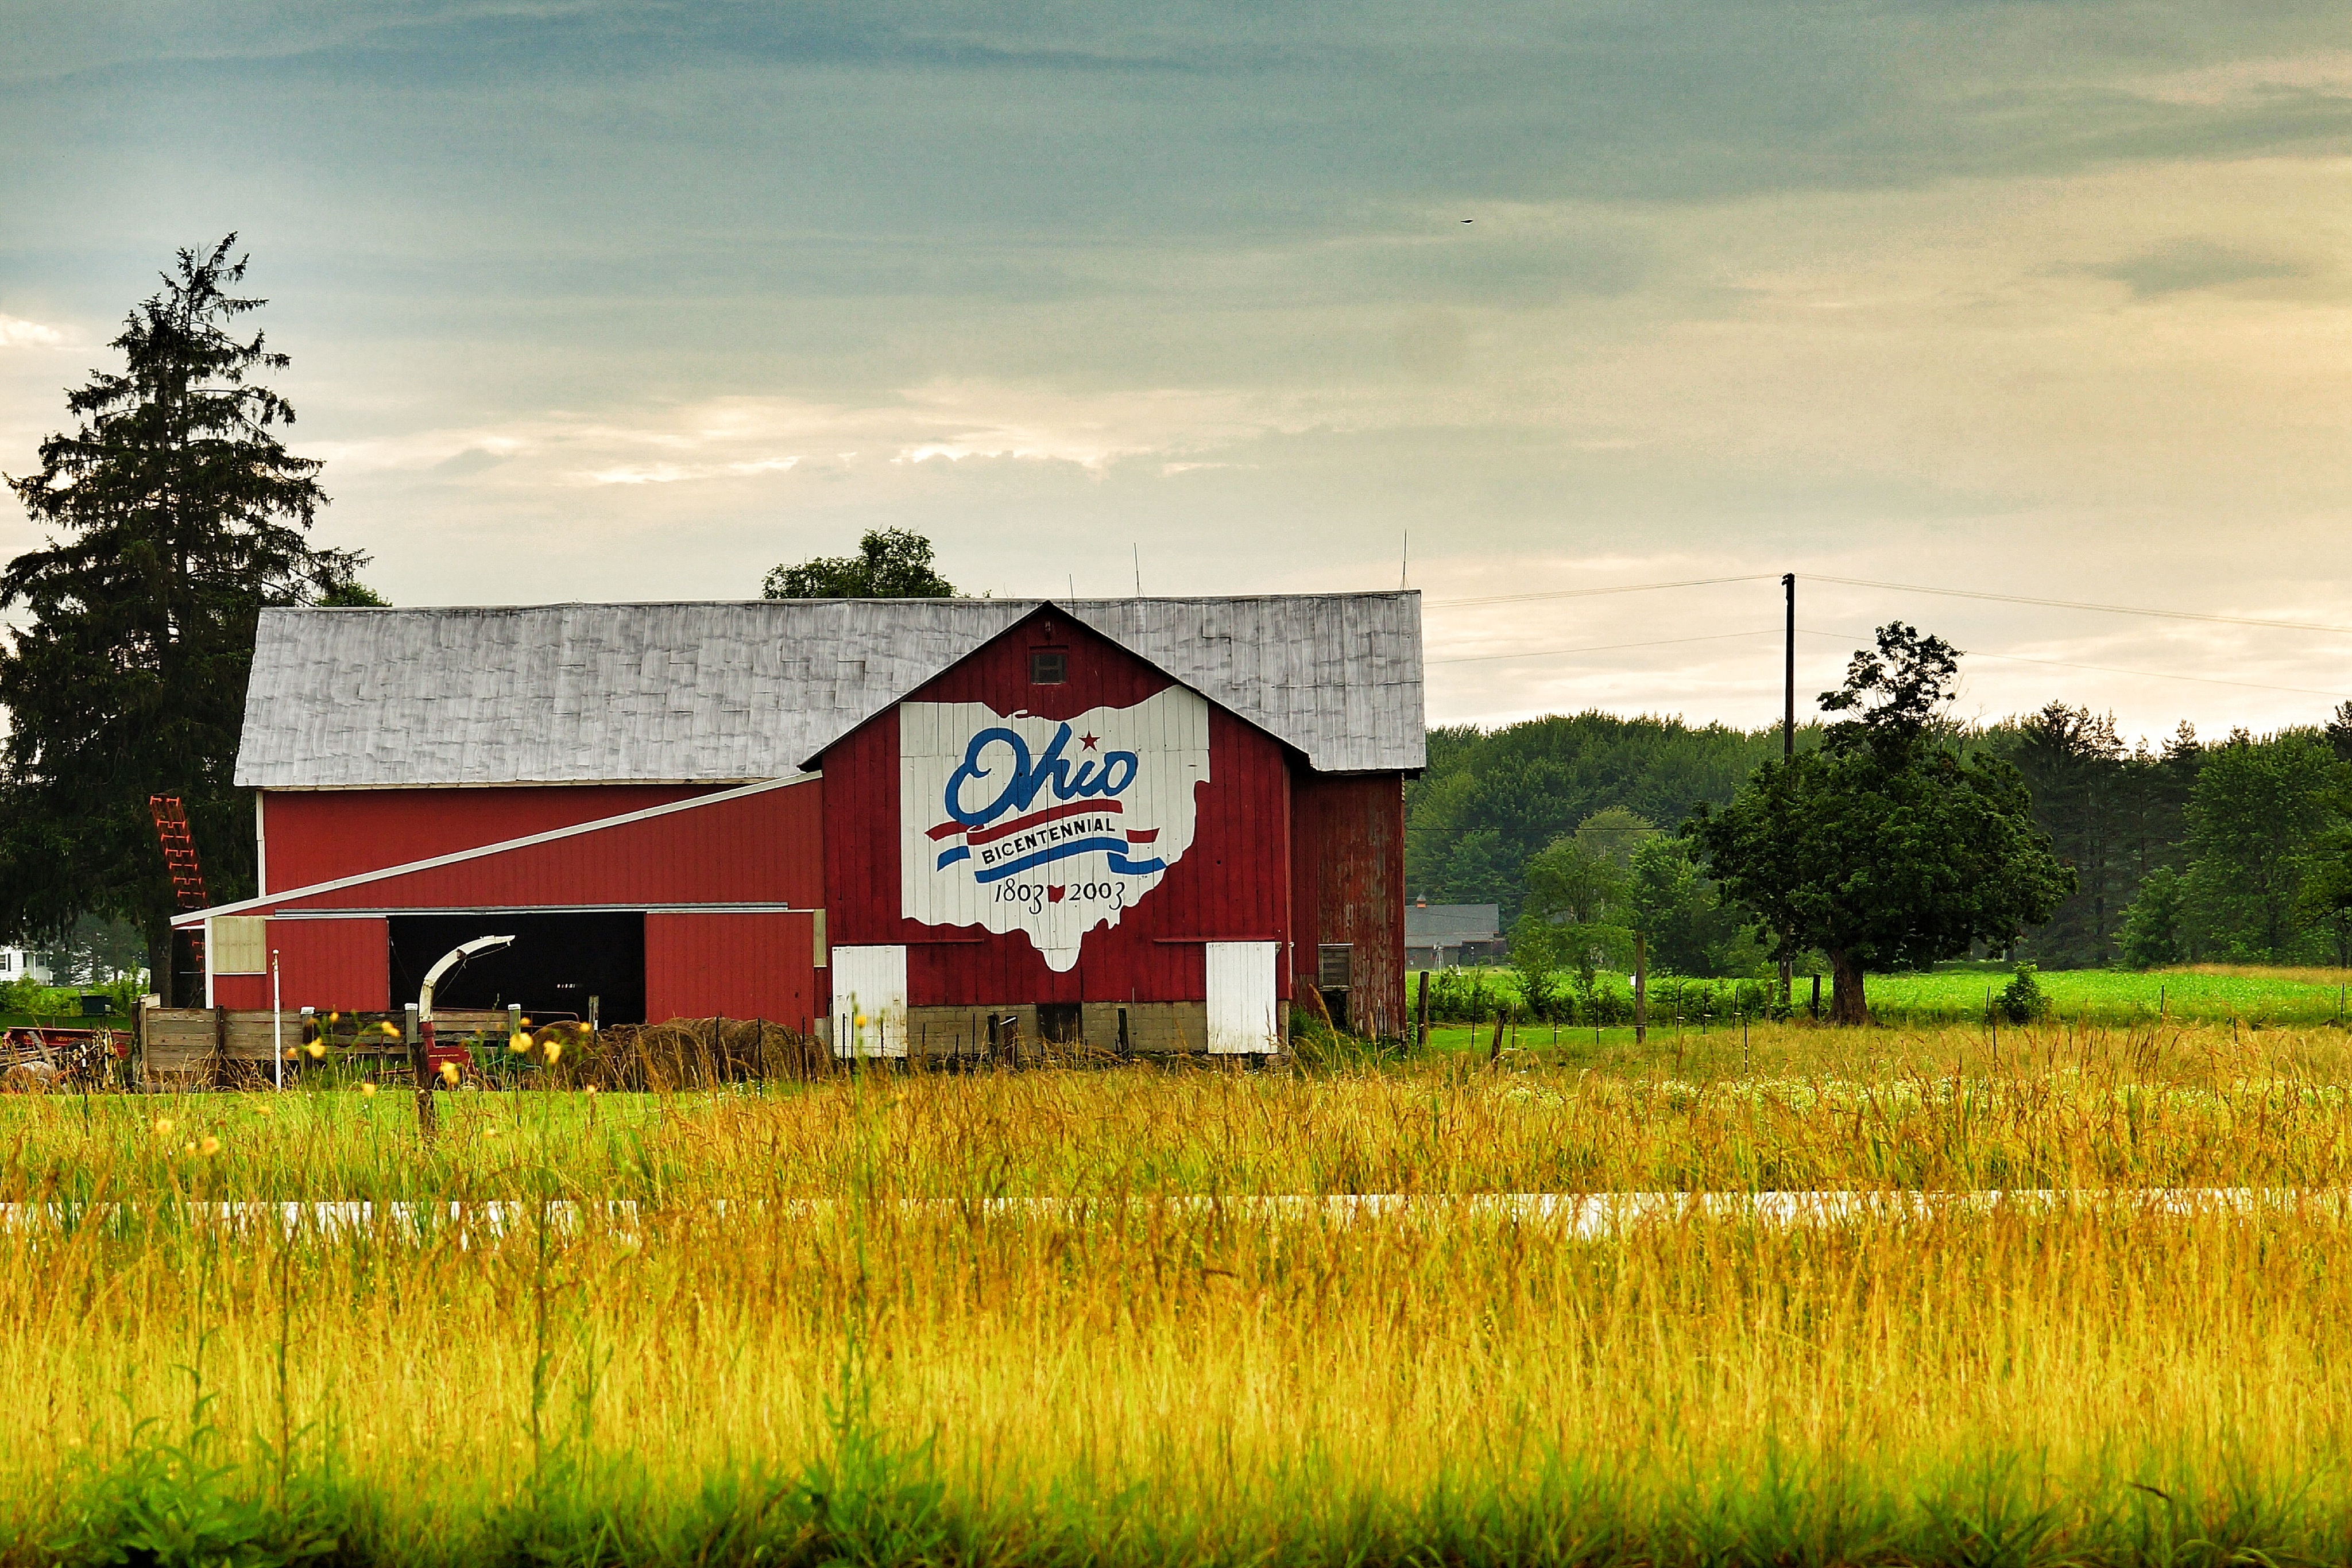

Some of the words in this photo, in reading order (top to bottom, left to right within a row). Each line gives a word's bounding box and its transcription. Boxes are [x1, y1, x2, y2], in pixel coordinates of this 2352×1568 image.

[945, 722, 1138, 826] Ohio
[981, 818, 1116, 865] BICENTENNIAL
[995, 878, 1044, 915] 1803
[1068, 881, 1125, 911] 2003
